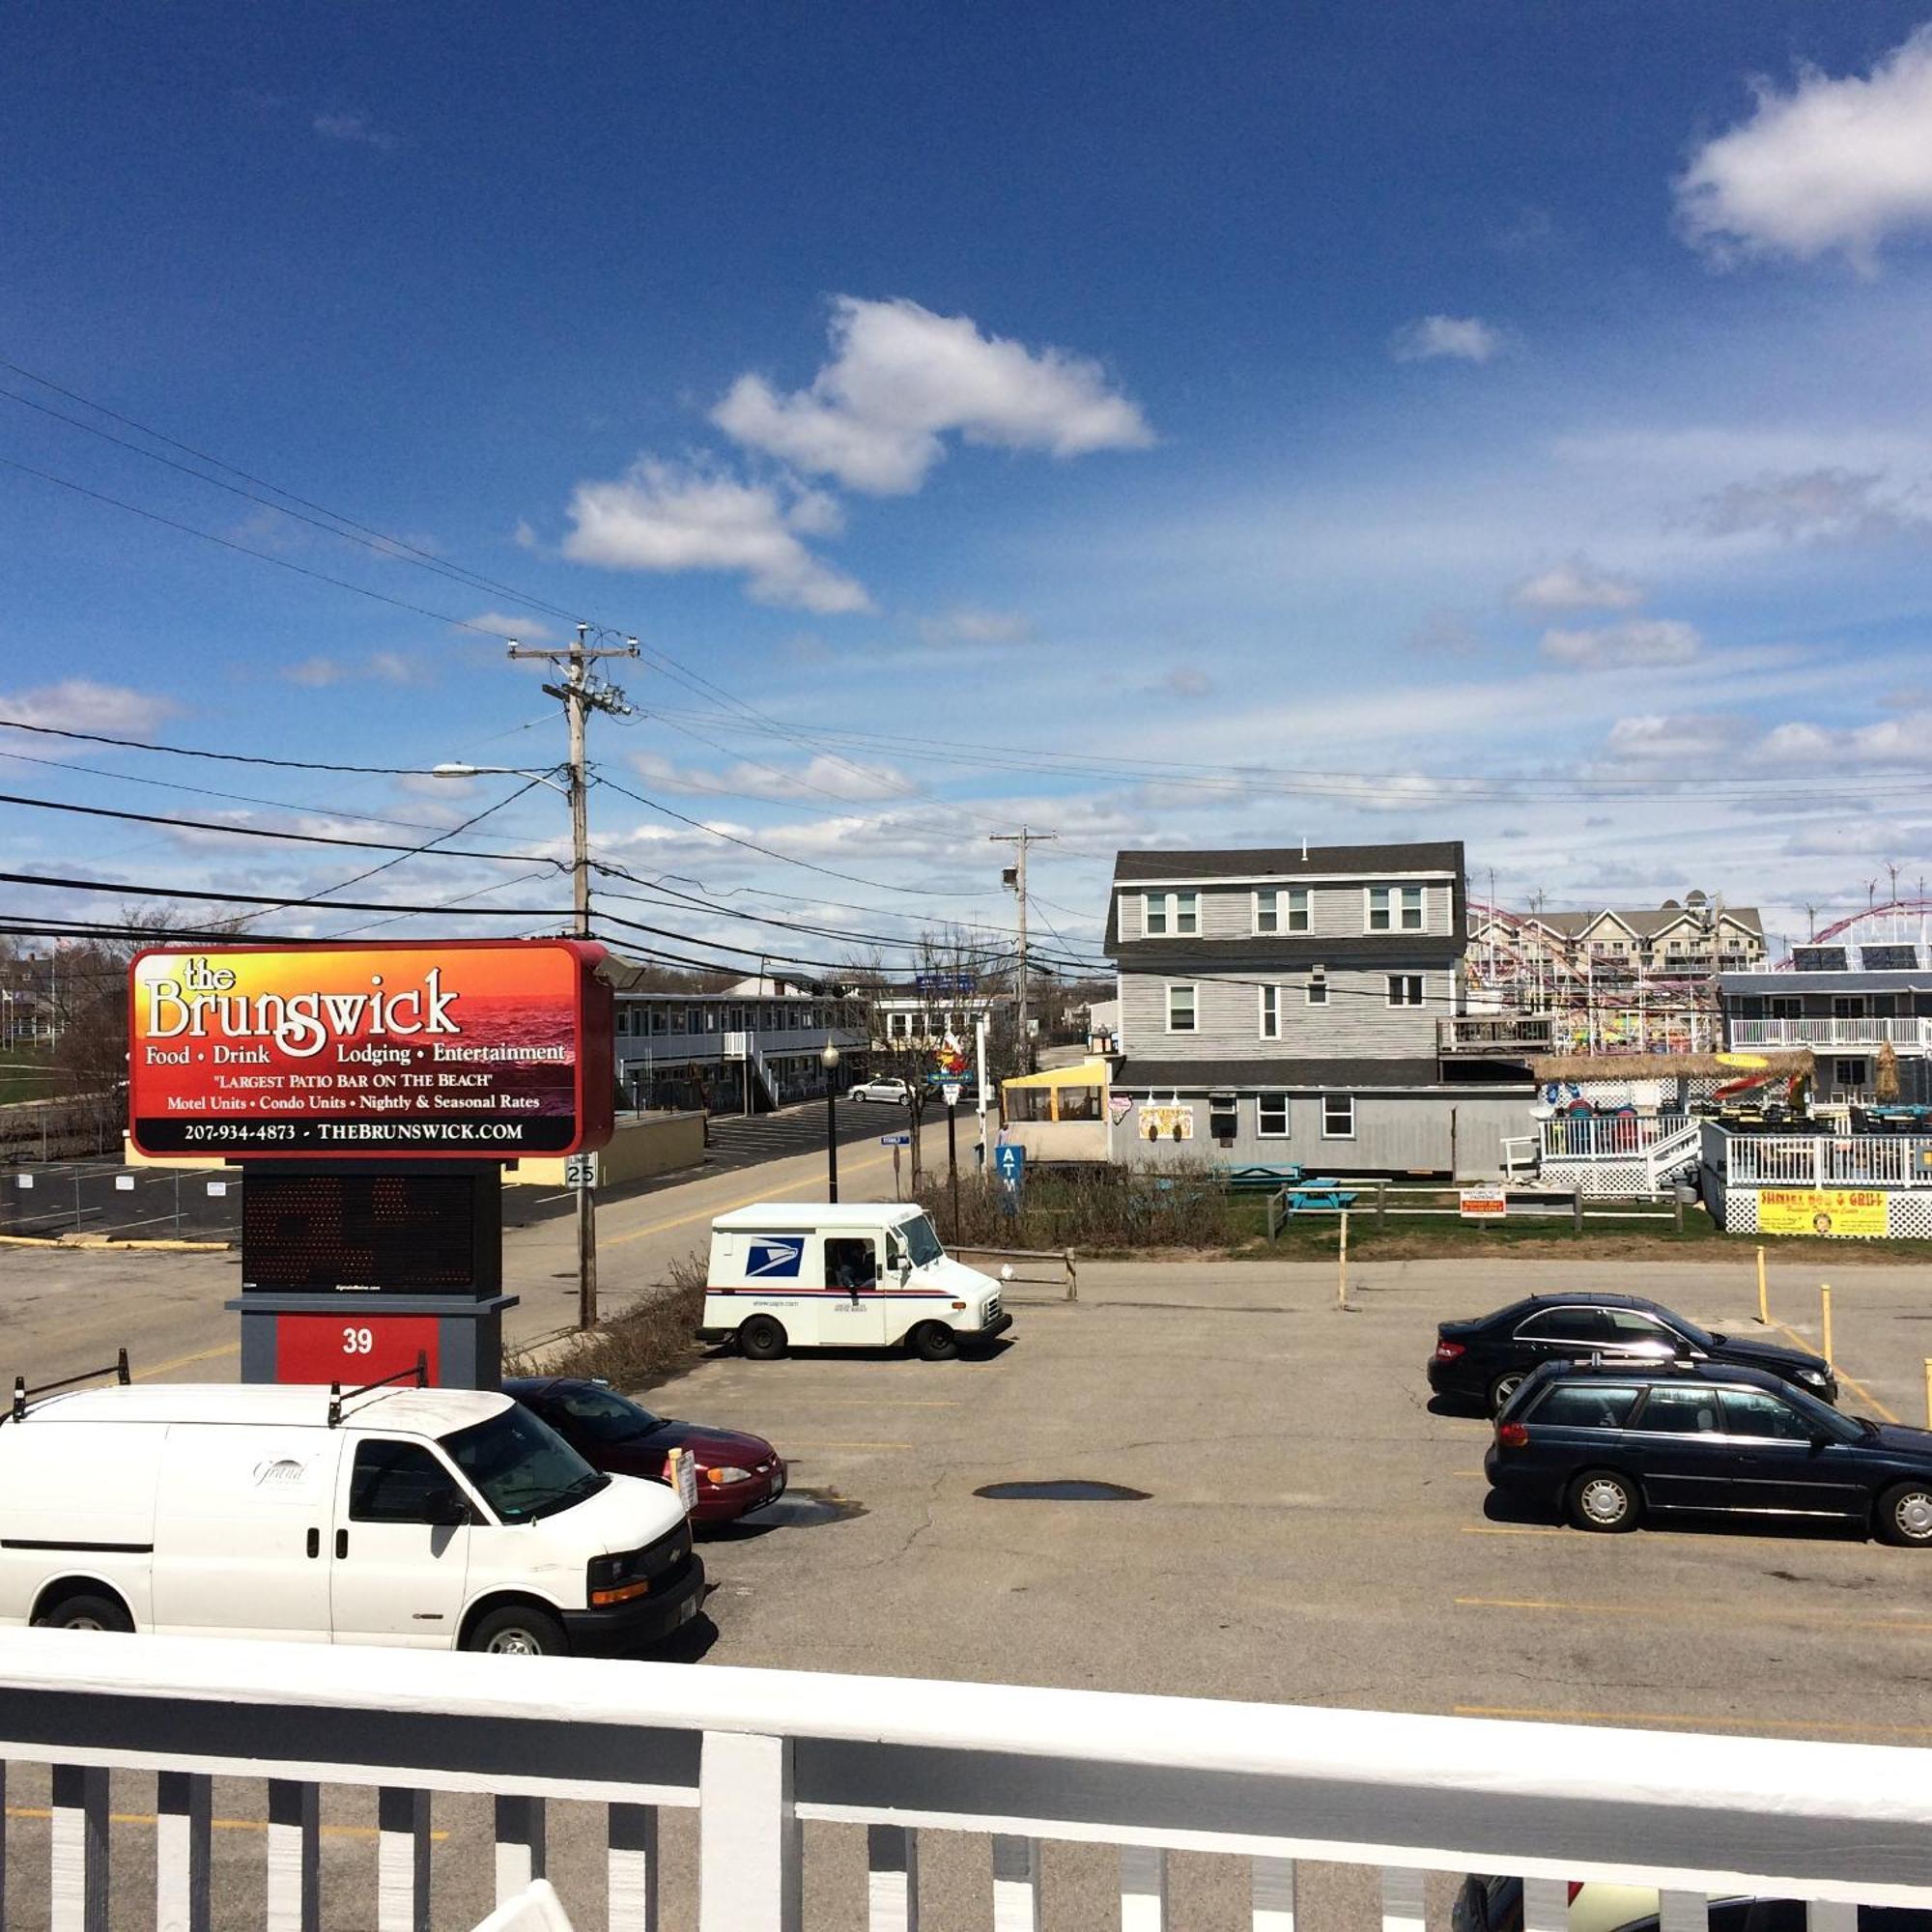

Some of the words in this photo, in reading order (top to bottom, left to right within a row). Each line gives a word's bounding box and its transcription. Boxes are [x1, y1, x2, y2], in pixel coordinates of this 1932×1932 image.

[184, 956, 236, 990] the
[145, 967, 463, 1058] Brunswick
[146, 1045, 190, 1064] Food
[213, 1044, 270, 1064] Drink
[337, 1043, 411, 1065] Lodging
[433, 1043, 565, 1062] Entertainment
[290, 1074, 332, 1088] PATIO
[337, 1074, 368, 1088] BAR
[373, 1074, 397, 1088] ON
[401, 1074, 434, 1087] THE
[167, 1096, 206, 1110] Motel
[211, 1096, 247, 1110] Units
[259, 1095, 304, 1110] Condo
[309, 1094, 346, 1109] Units
[359, 1094, 412, 1111] Nightly
[416, 1094, 430, 1109] &
[435, 1094, 496, 1109] Seasonal
[499, 1094, 540, 1108] Rates
[185, 1124, 296, 1141] 207-934-4873
[317, 1123, 524, 1140] THEBRUNSWICK.COM
[568, 1166, 594, 1181] 25
[342, 1327, 373, 1353] 39
